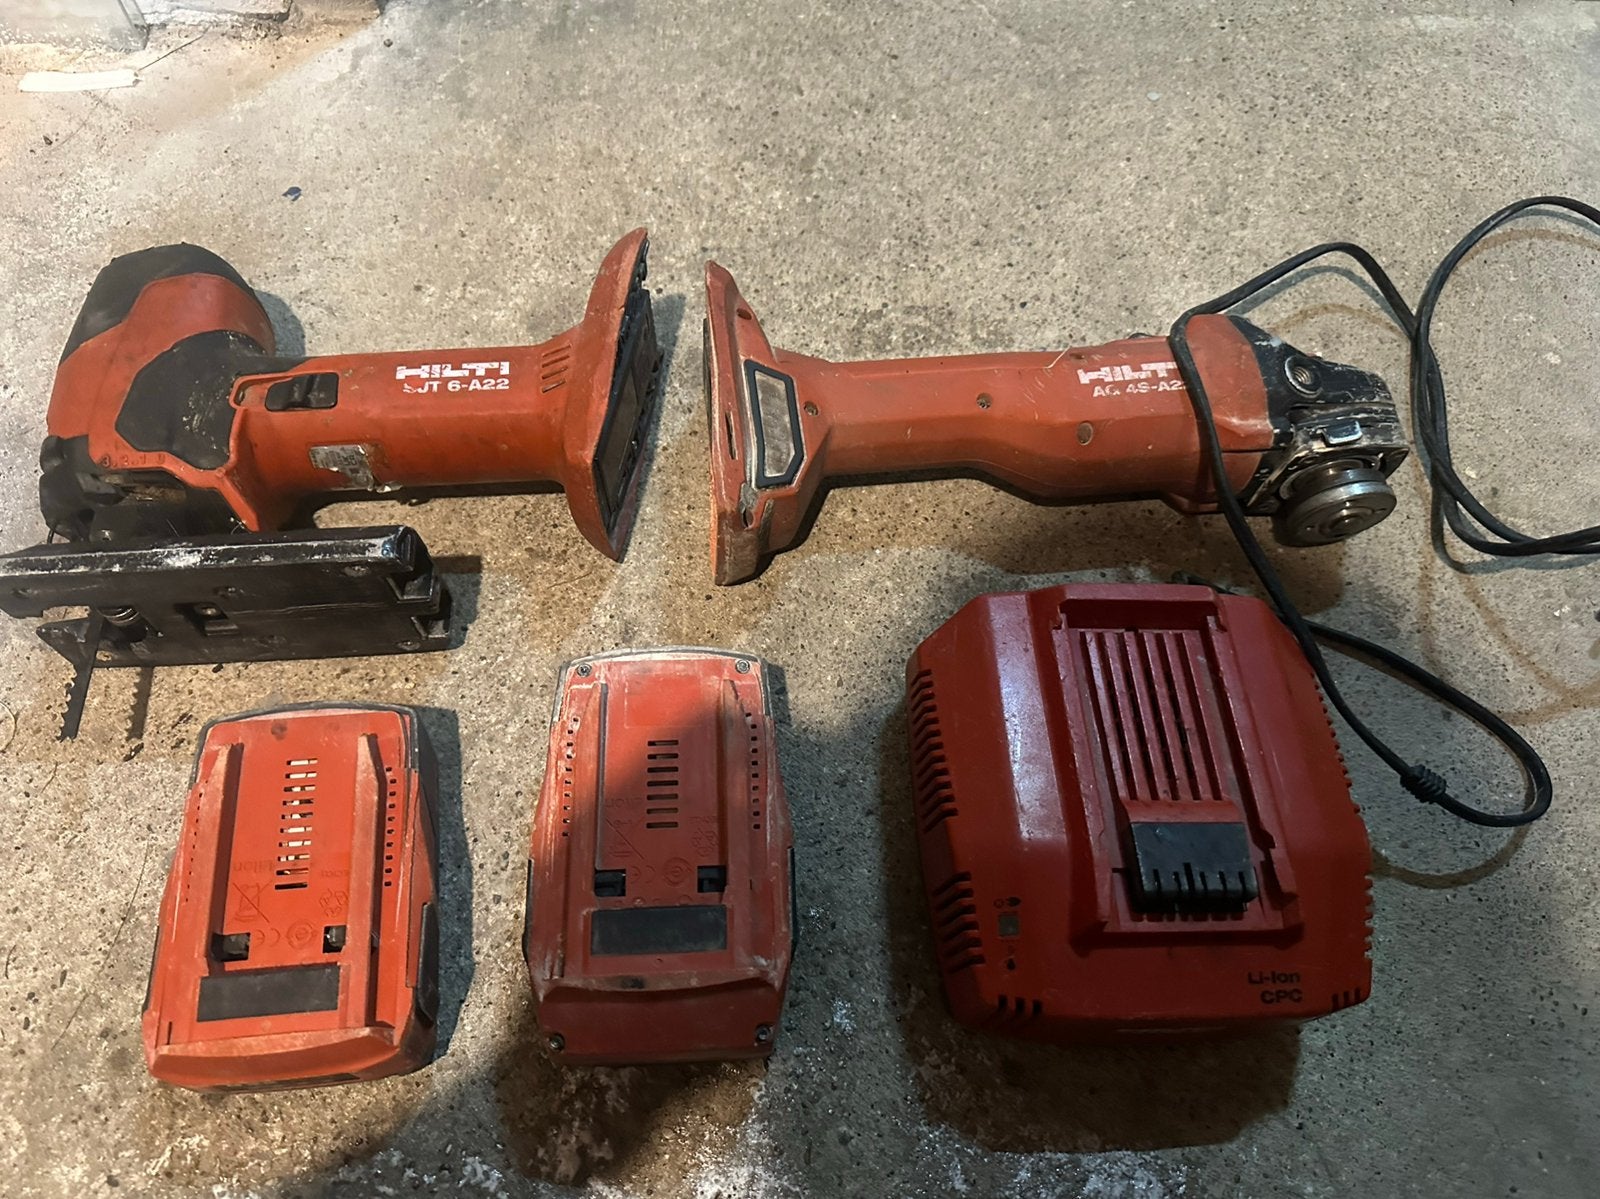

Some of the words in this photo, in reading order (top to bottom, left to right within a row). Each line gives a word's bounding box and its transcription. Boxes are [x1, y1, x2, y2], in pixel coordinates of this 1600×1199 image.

[395, 361, 510, 380] HILTI
[1076, 361, 1179, 384] HILT
[447, 378, 510, 392] 6-A22
[1260, 988, 1303, 1004] CPC
